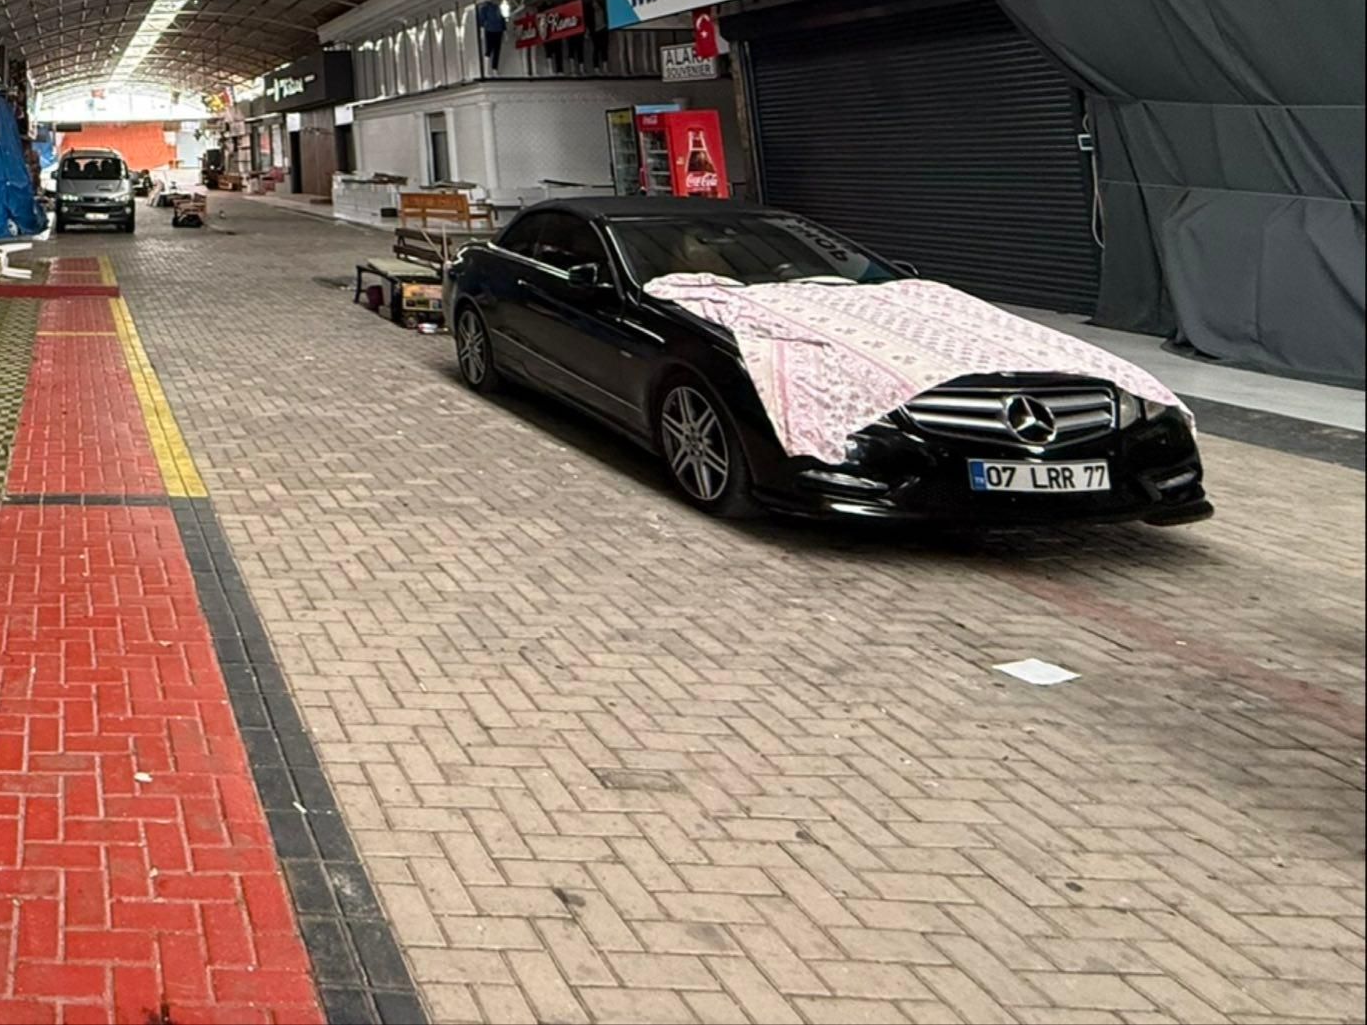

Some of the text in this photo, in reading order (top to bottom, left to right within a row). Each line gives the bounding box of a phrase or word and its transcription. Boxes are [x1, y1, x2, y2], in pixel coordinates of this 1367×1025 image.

[987, 465, 1105, 489] 07 LRR 77
